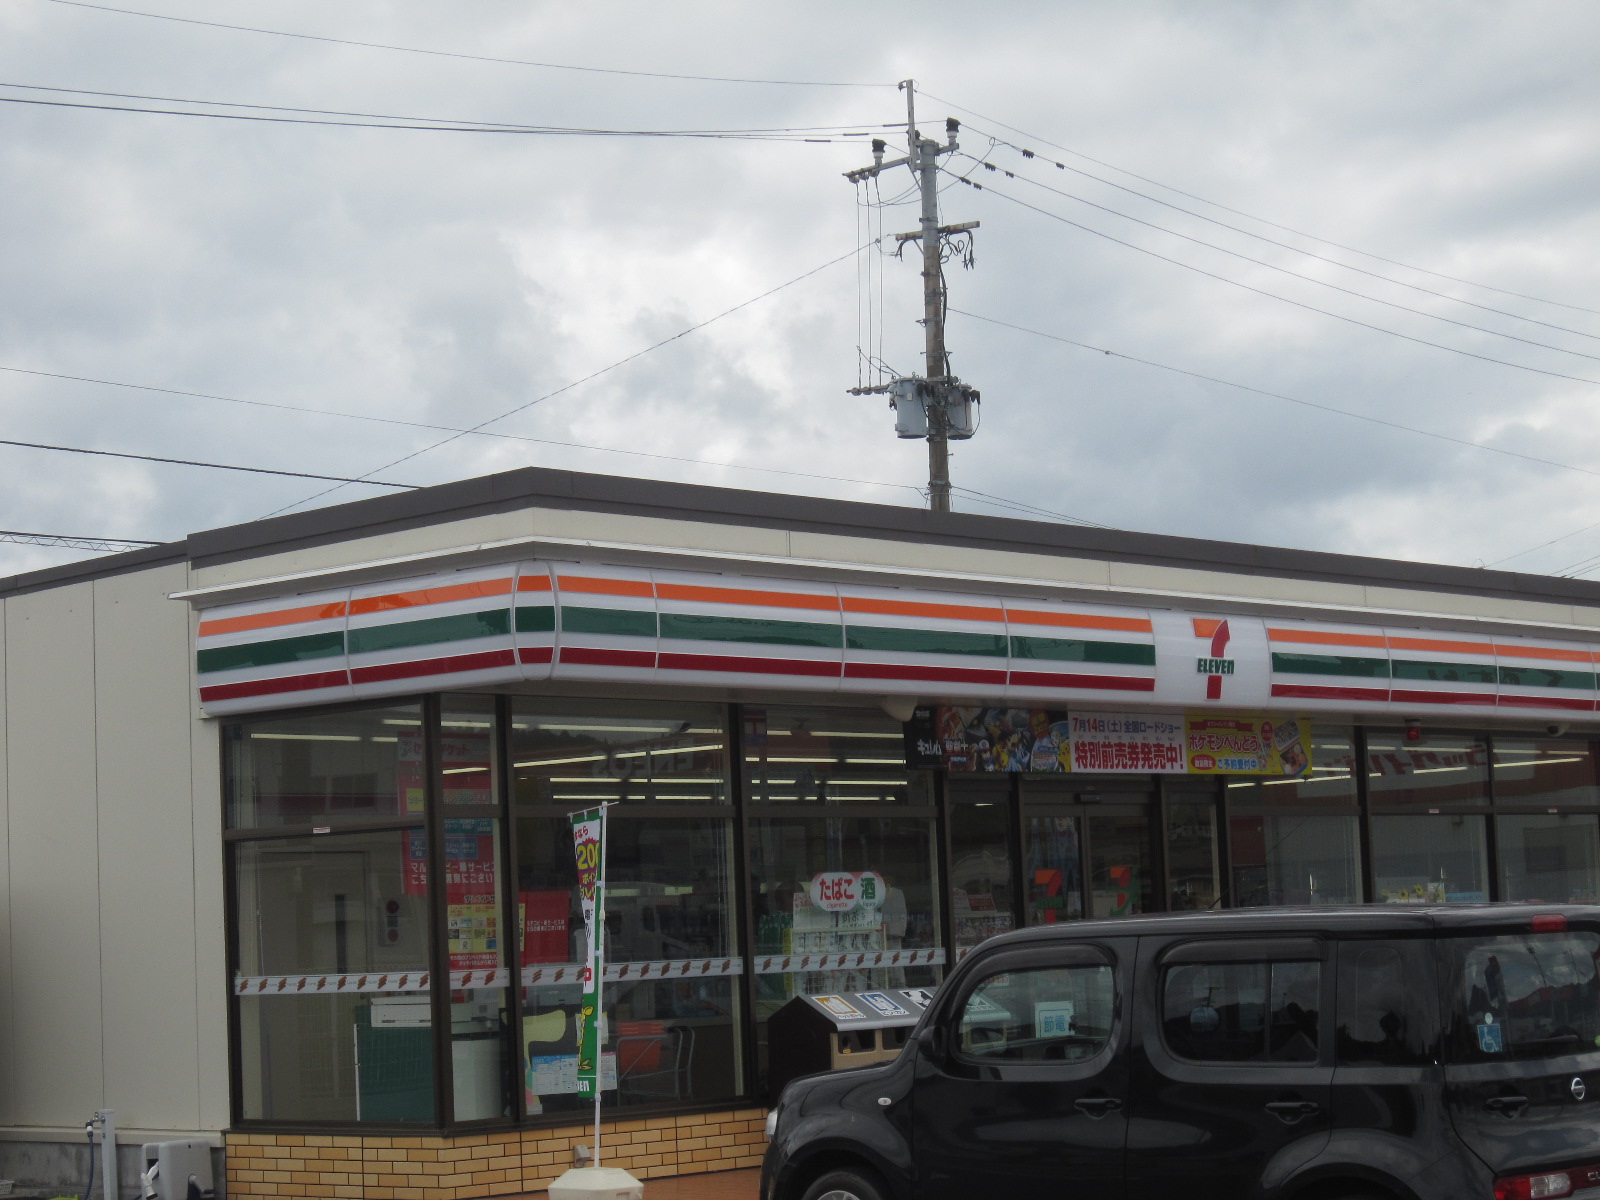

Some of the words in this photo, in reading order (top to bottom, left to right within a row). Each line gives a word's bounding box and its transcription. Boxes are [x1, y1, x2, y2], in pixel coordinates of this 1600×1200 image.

[819, 877, 855, 901] たばこ
[860, 877, 876, 900] 酒
